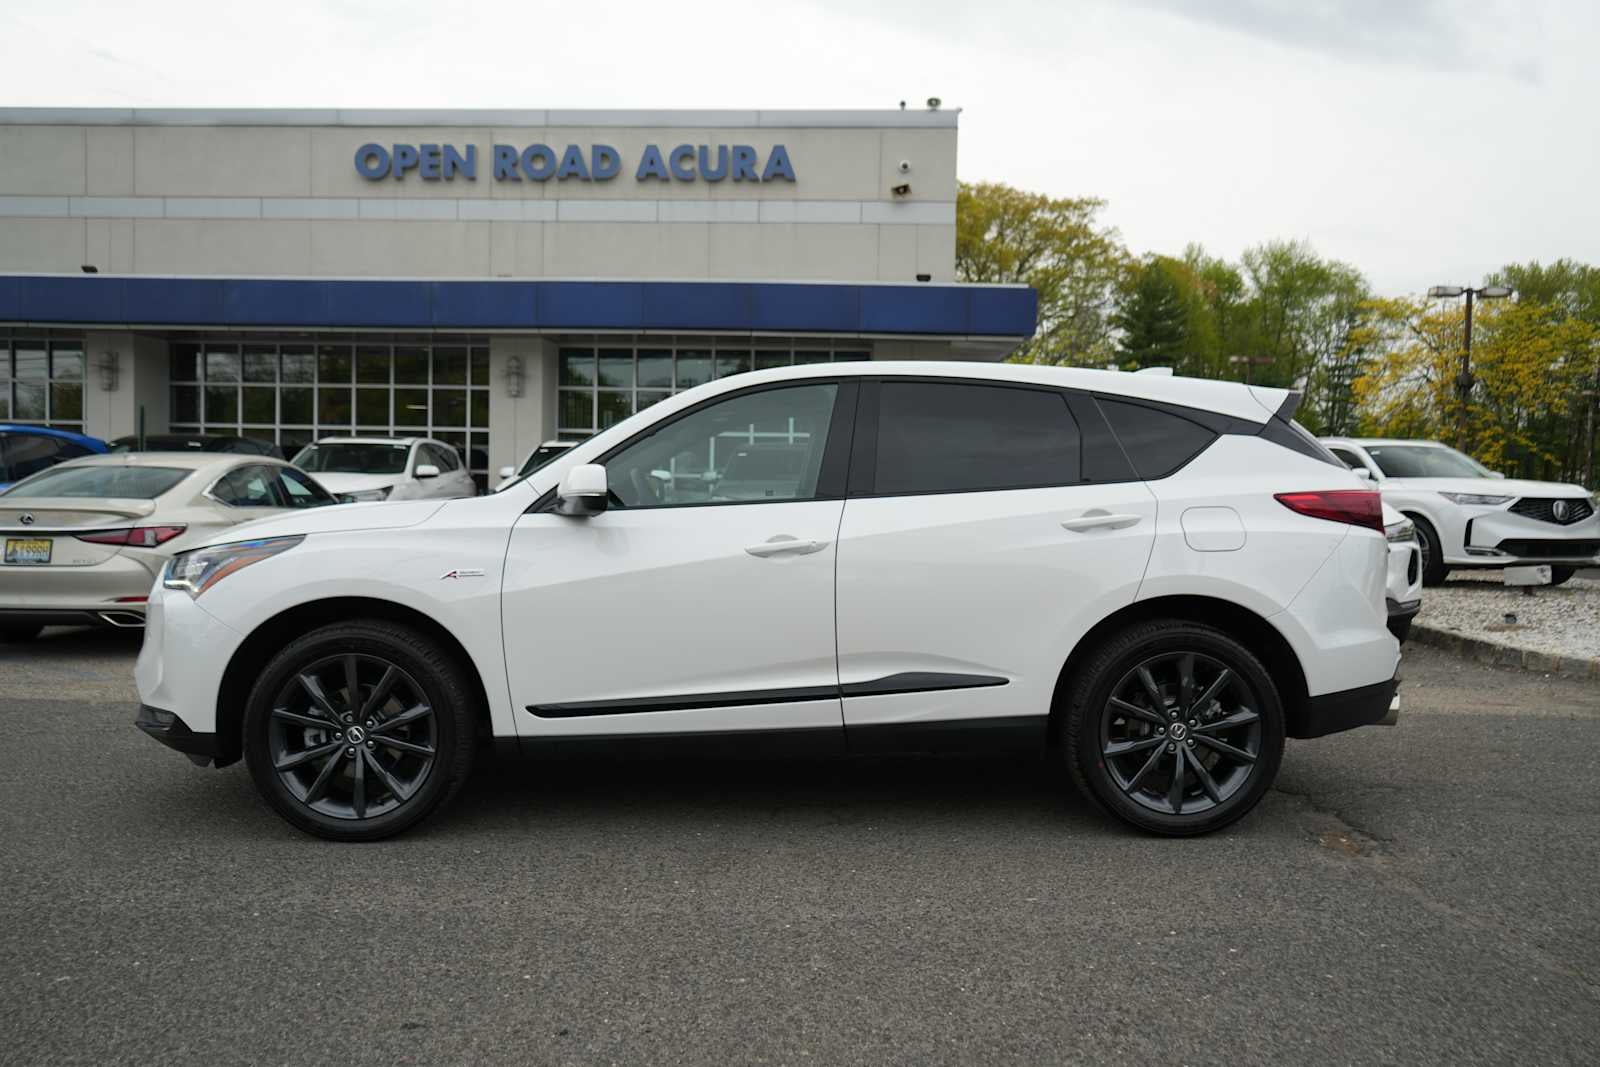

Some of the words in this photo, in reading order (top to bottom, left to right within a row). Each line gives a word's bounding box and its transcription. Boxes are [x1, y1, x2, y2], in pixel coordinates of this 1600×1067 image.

[354, 143, 477, 182] OPEN
[493, 144, 621, 182] ROAD
[636, 144, 796, 183] ACURA
